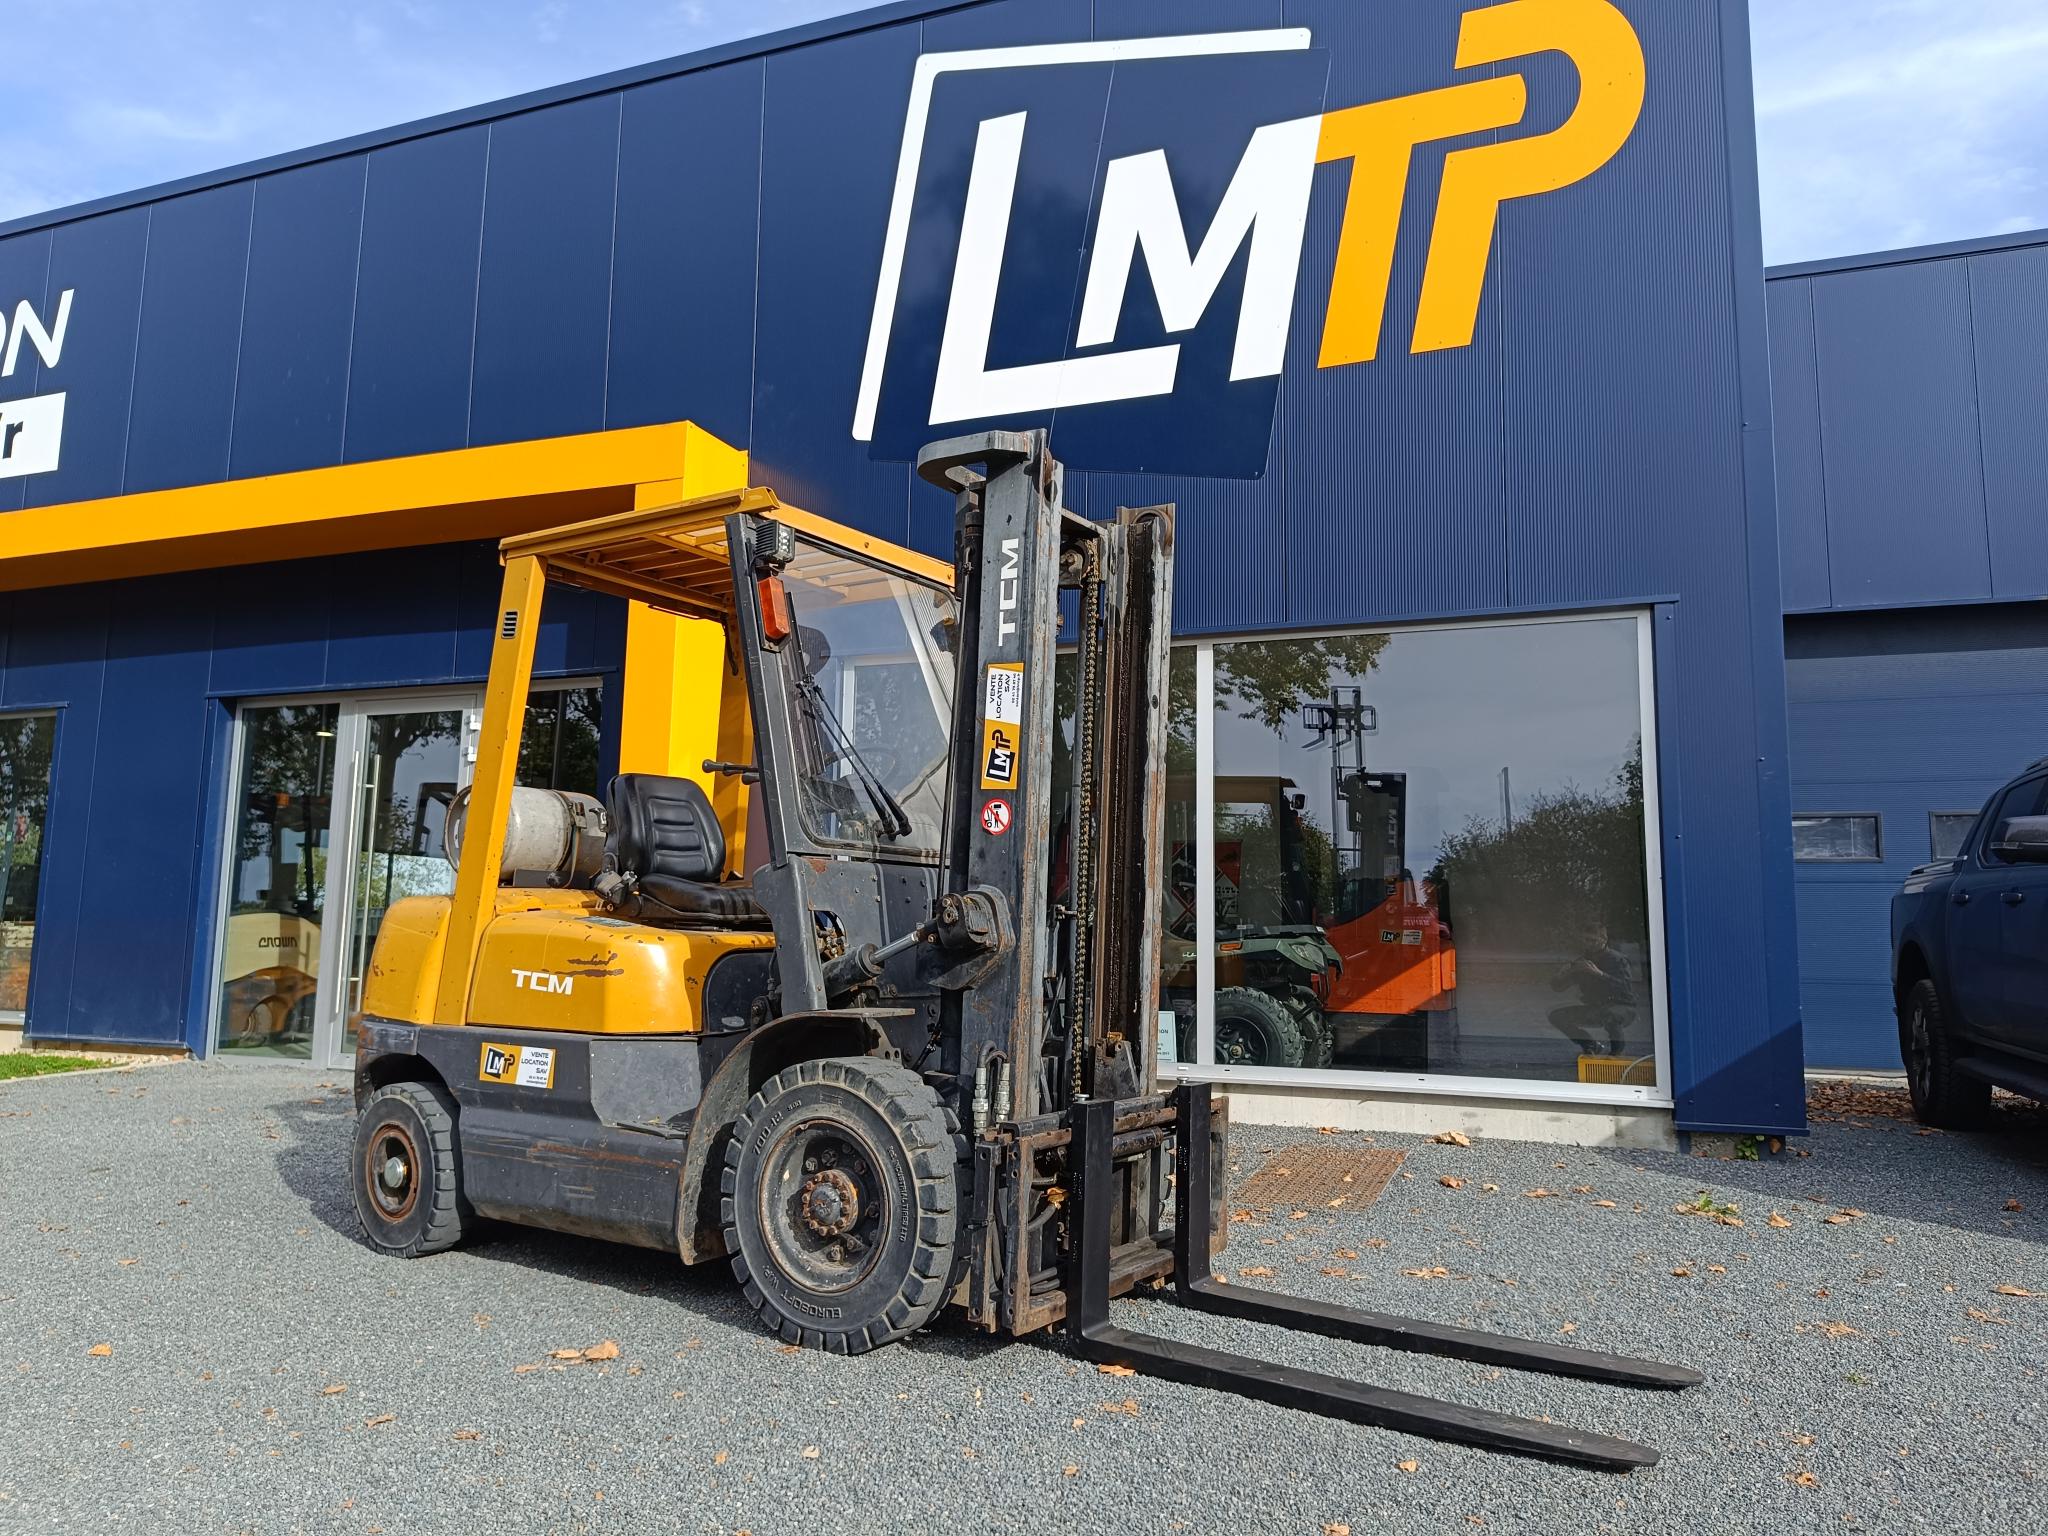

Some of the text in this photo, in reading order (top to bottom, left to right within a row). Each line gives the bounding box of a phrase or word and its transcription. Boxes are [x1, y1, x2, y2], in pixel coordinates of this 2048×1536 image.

[928, 0, 1646, 426] LMTP
[0, 288, 75, 378] N
[0, 411, 24, 460] r
[998, 538, 1019, 647] TCM
[989, 673, 997, 704] VENTE
[995, 673, 1004, 719] LOCATION
[989, 729, 1011, 778] LMTP
[511, 968, 574, 996] TCM
[486, 1050, 516, 1075] LMTP
[521, 1058, 548, 1066] LOCATION
[780, 1290, 842, 1318] EUROSOFT
